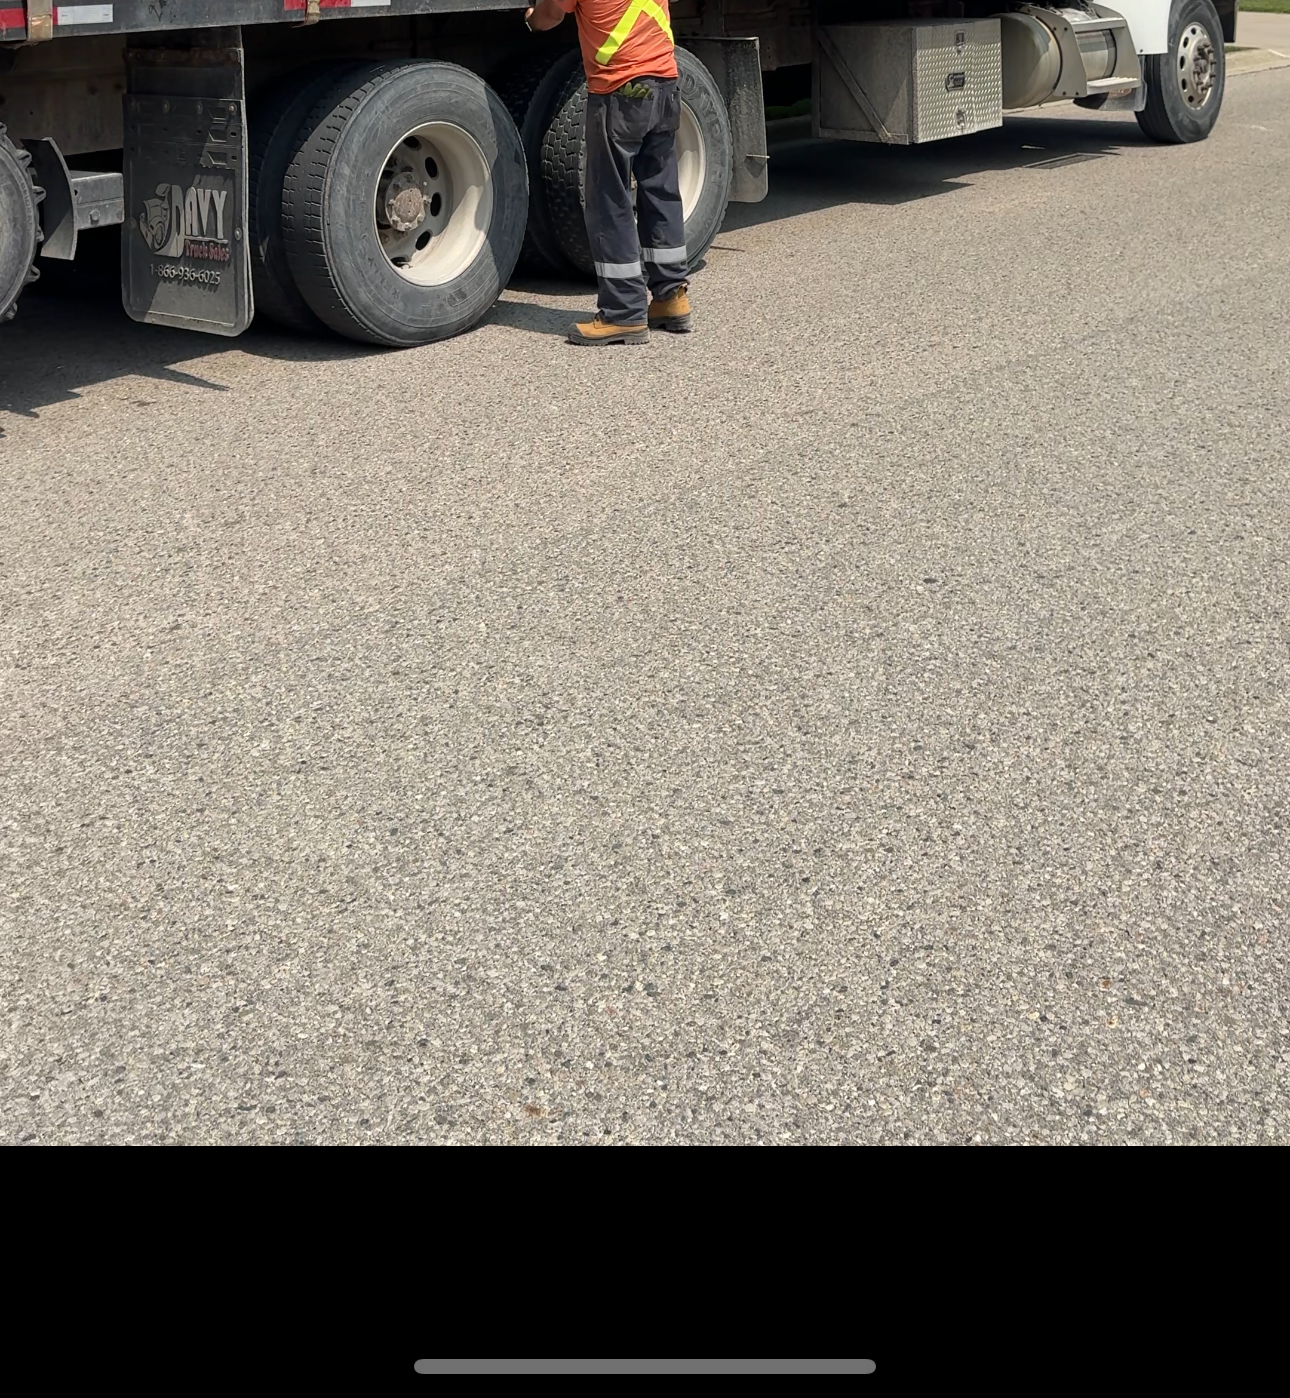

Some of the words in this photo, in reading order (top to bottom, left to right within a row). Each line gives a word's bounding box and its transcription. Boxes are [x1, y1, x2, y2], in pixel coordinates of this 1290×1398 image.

[154, 184, 227, 258] DAVY
[184, 240, 208, 258] Truck
[208, 242, 230, 262] Sales
[149, 263, 221, 285] 1-866-936-6025
